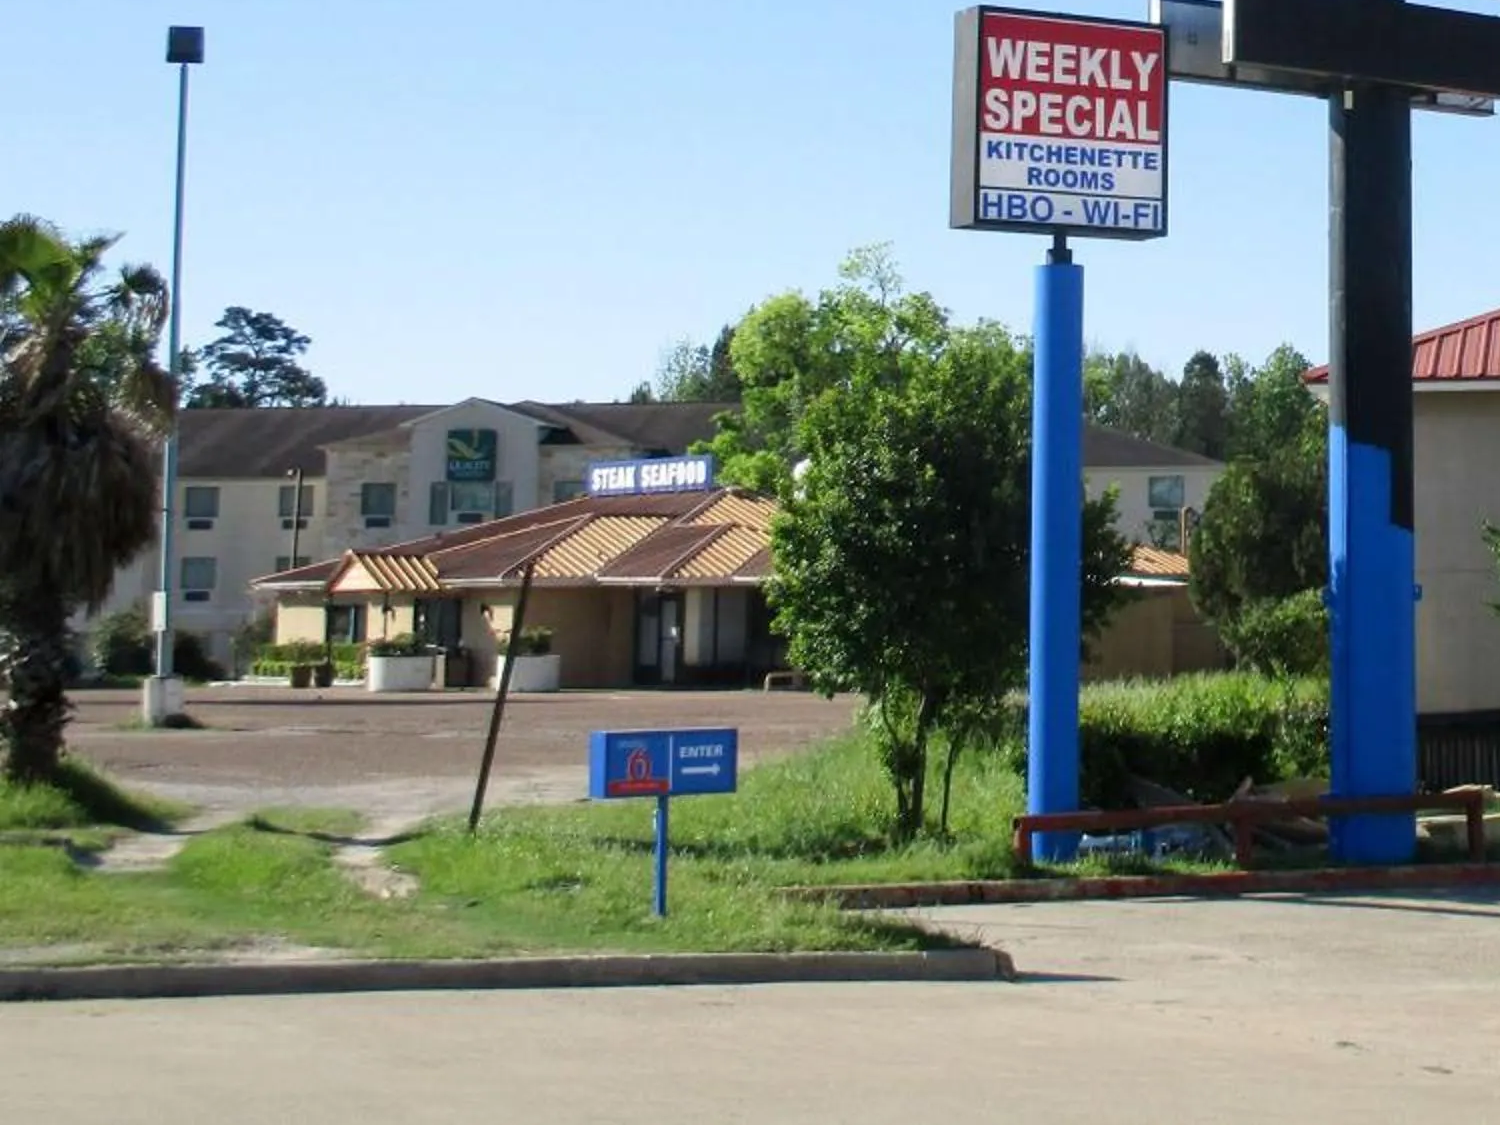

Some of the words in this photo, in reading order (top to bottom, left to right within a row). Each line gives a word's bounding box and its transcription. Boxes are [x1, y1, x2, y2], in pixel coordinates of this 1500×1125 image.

[987, 36, 1160, 92] WEEKLY
[983, 88, 1160, 141] SPECIAL
[987, 140, 1159, 171] KITCHENETTE
[1027, 167, 1115, 191] ROOMS
[981, 192, 1054, 222] HBO
[1082, 198, 1160, 229] WI-FI
[591, 466, 636, 492] STEAK
[641, 460, 707, 488] SEAFOOD
[679, 744, 724, 759] ENTER
